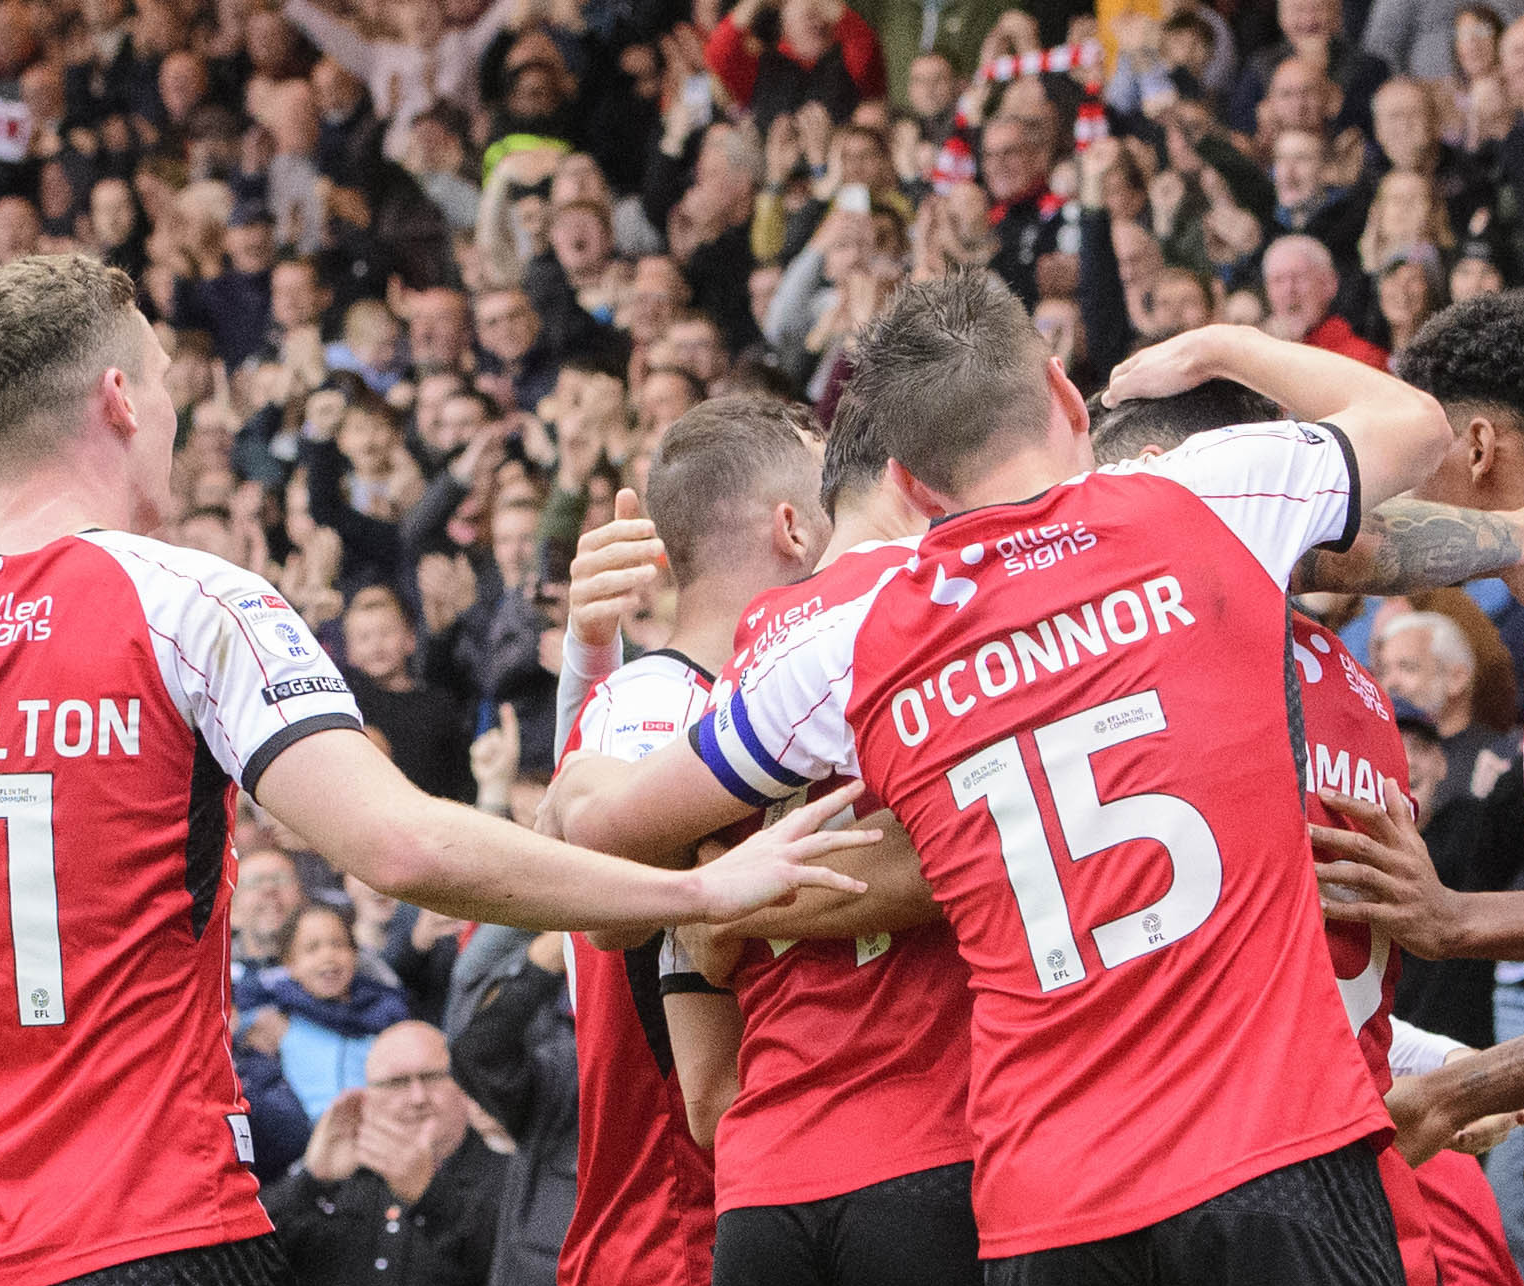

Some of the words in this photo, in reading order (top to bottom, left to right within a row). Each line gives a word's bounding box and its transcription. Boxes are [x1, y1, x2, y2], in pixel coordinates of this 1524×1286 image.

[1003, 526, 1098, 577] signs
[238, 598, 263, 610] sky
[753, 595, 823, 656] allen
[288, 646, 310, 657] EFL
[892, 574, 1196, 748] O'CONNOR
[615, 723, 640, 734] sky
[643, 720, 674, 731] bet
[945, 689, 1223, 993] 15
[1148, 931, 1165, 945] EFL
[1053, 969, 1071, 981] EFL
[34, 1009, 50, 1019] EFL
